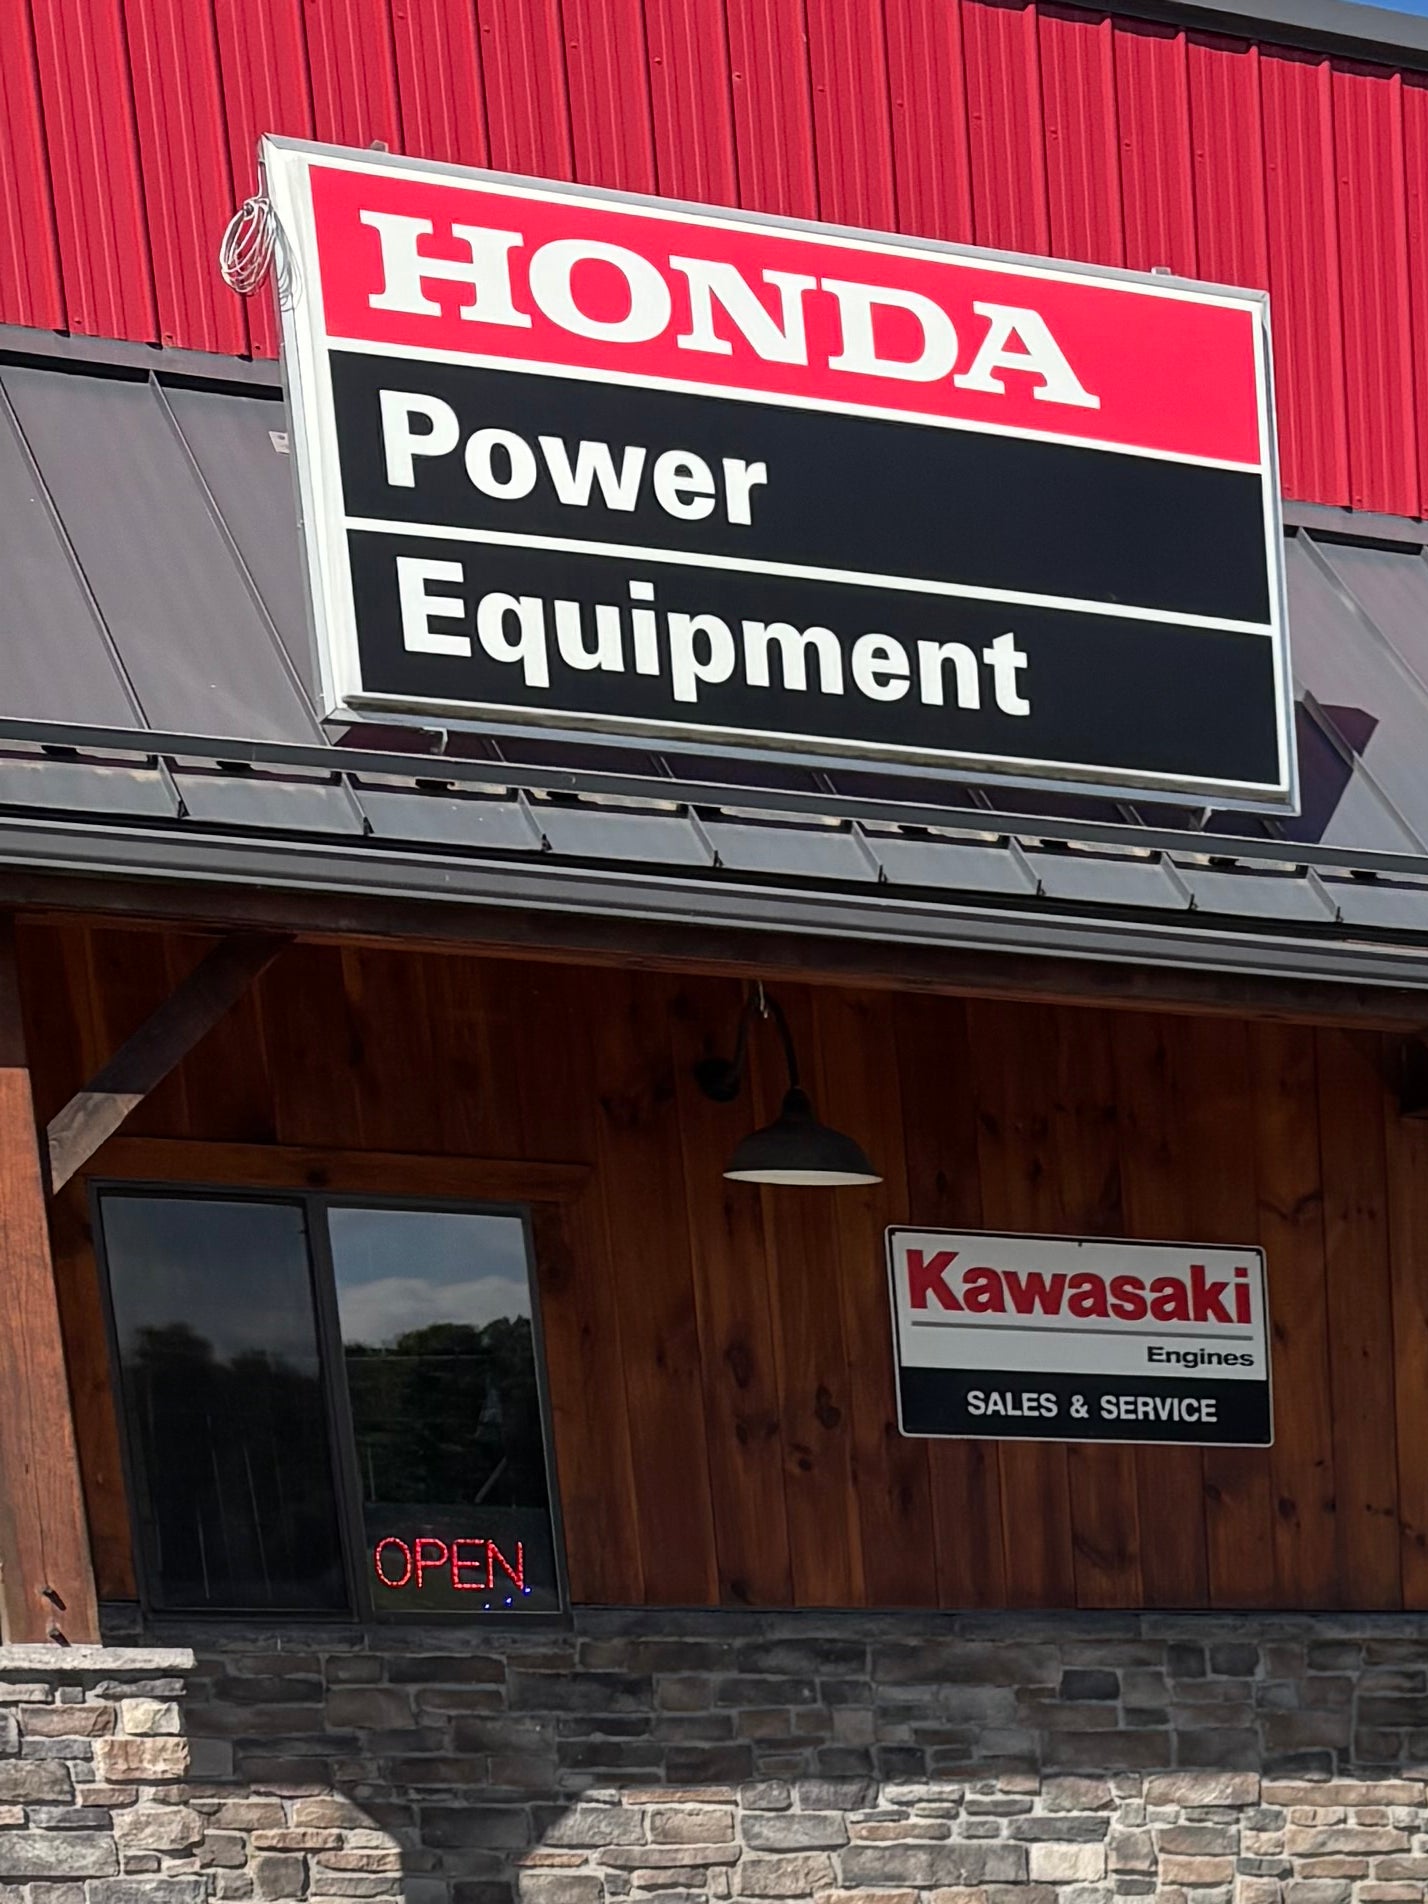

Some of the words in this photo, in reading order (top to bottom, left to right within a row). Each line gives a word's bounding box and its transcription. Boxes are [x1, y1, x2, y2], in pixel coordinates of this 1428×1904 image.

[360, 209, 1101, 410] HONDA
[379, 388, 768, 526] Power
[396, 555, 1031, 717] Equipment
[905, 1249, 1253, 1324] Kawasaki
[1146, 1345, 1255, 1369] Engines
[966, 1390, 1059, 1418] SALES
[1069, 1394, 1089, 1419] &
[1100, 1394, 1219, 1423] SERVICE
[374, 1536, 526, 1591] OPEN
